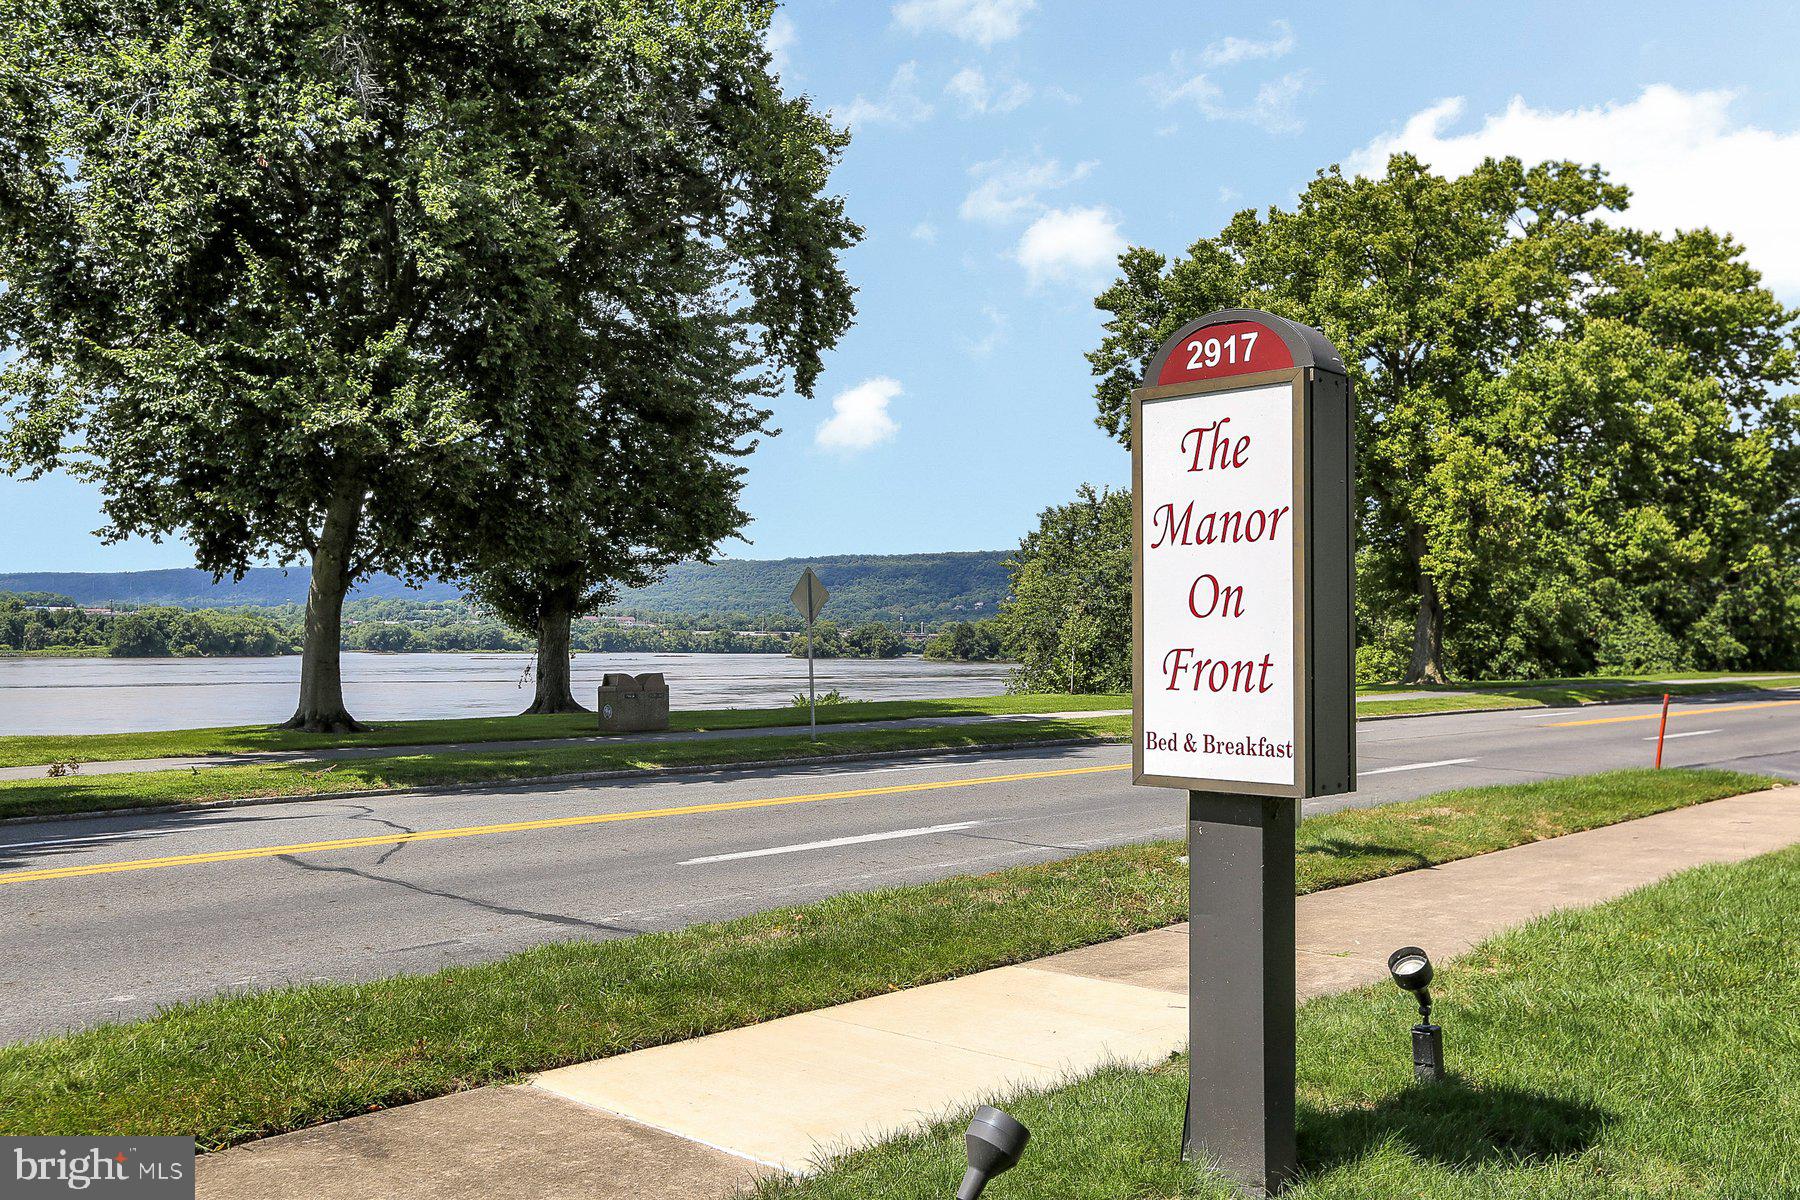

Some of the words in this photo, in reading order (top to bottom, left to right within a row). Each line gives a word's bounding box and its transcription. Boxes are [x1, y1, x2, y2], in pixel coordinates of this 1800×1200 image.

[1186, 331, 1258, 370] 2917
[1181, 417, 1251, 472] The
[1151, 500, 1289, 549] Manor
[1188, 574, 1245, 618] On
[1162, 648, 1274, 693] Front
[1146, 731, 1178, 752] Bed
[1183, 732, 1197, 753] &
[1203, 733, 1293, 759] Breakfast
